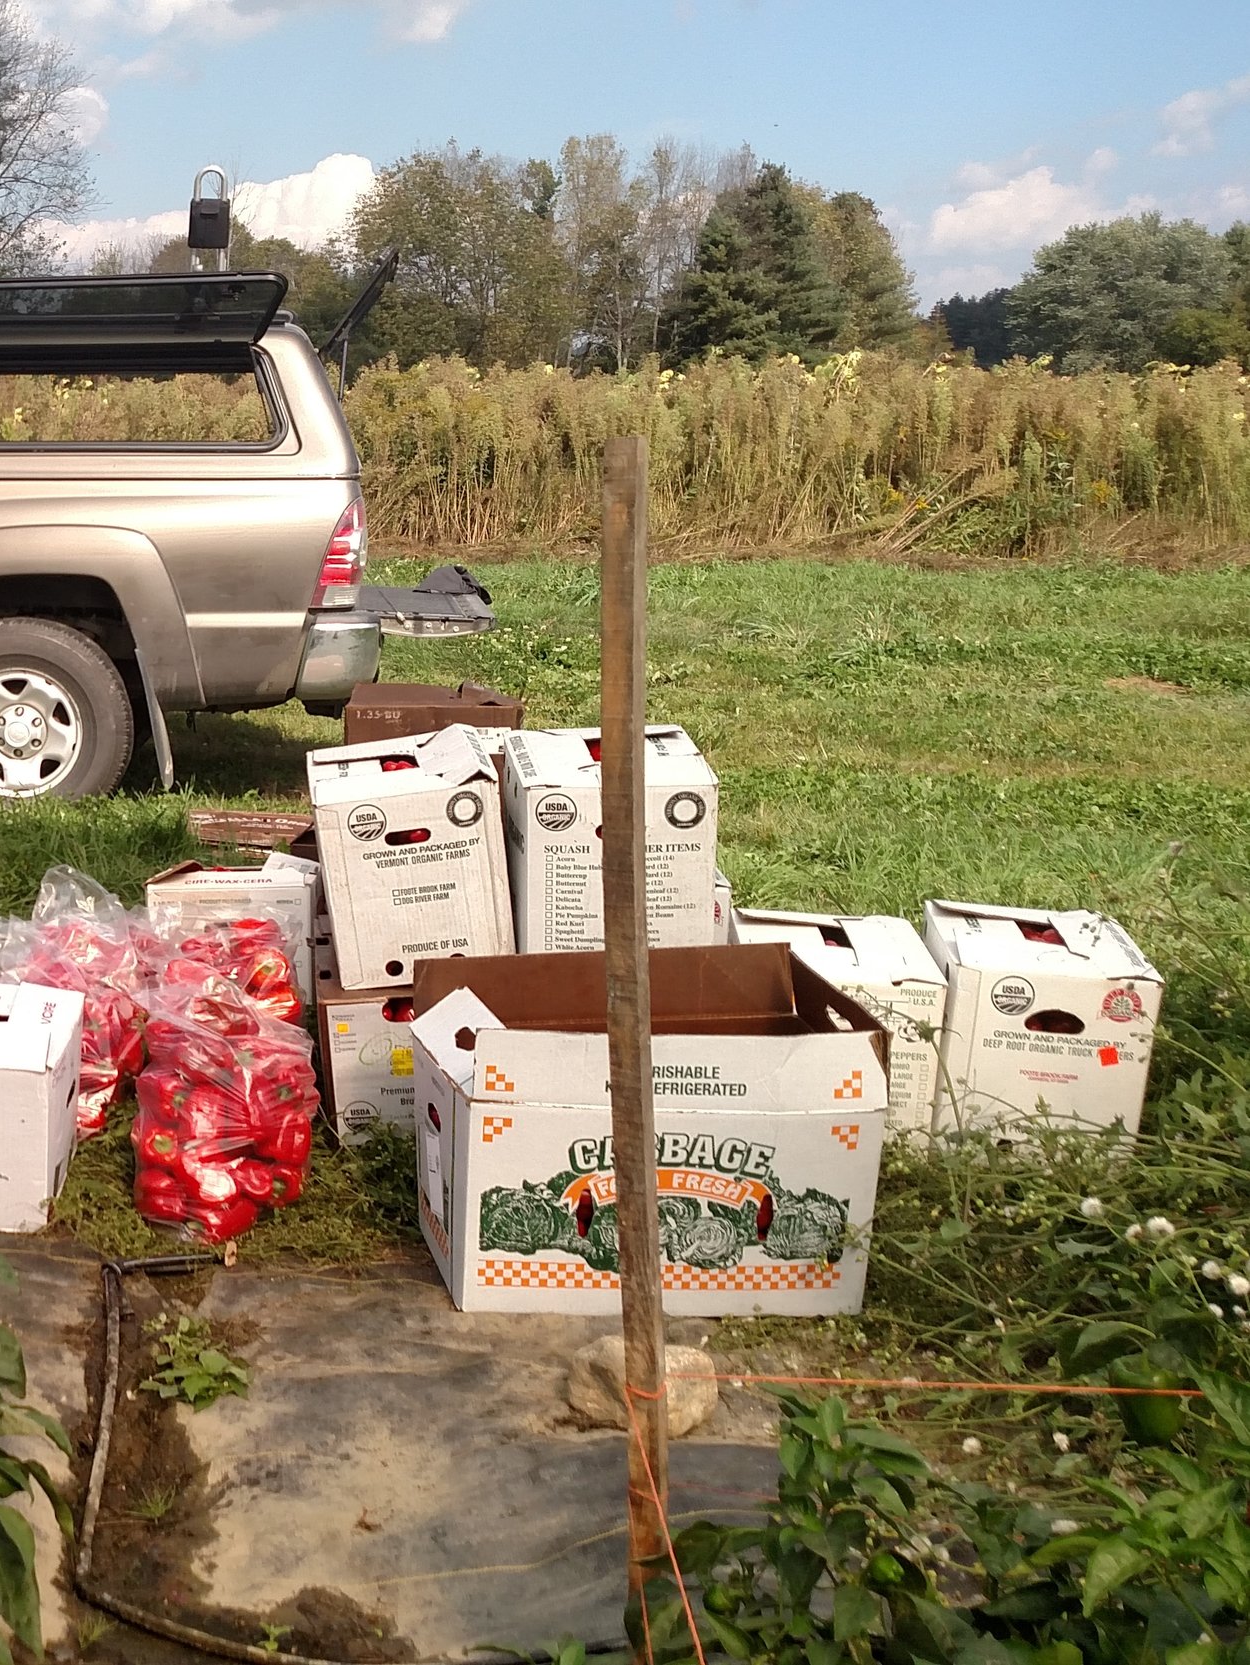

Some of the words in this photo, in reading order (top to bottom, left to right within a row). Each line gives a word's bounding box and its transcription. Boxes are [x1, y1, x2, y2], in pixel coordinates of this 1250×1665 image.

[545, 802, 568, 812] USDA
[356, 812, 377, 823] USDA
[362, 849, 396, 861] GROWN
[399, 847, 417, 856] AND
[419, 841, 467, 854] PACKAGED
[469, 837, 481, 847] BY
[544, 845, 590, 854] SQUASH
[666, 842, 701, 853] ITEMS
[375, 857, 409, 869] VERMONT
[411, 853, 444, 865] ORGANIC
[446, 848, 471, 861] FARMS
[400, 887, 418, 896] FOOTE
[419, 885, 439, 894] BROOK
[439, 882, 456, 891] FARM
[402, 897, 414, 905] DOG
[414, 895, 432, 903] RIVER
[433, 892, 450, 901] FARM
[402, 941, 439, 953] PRODUCE
[440, 939, 450, 949] OF
[452, 938, 469, 948] USA
[900, 988, 937, 998] PRODUCE
[1002, 985, 1026, 995] USDA
[993, 1029, 1031, 1040] GROWN
[1034, 1034, 1055, 1043] AND
[1057, 1036, 1110, 1047] PACKAGED
[1113, 1041, 1127, 1049] BY
[982, 1038, 1003, 1048] DEEP
[1006, 1041, 1026, 1051] ROOT
[1028, 1044, 1065, 1055] ORGANIC
[1068, 1048, 1093, 1057] TRUCK
[652, 1065, 720, 1080] RISHABLE
[654, 1082, 747, 1097] EFRIGERATED
[890, 1091, 911, 1099] EDIUM
[350, 1108, 370, 1116] USDA
[672, 1172, 743, 1200] FRESH
